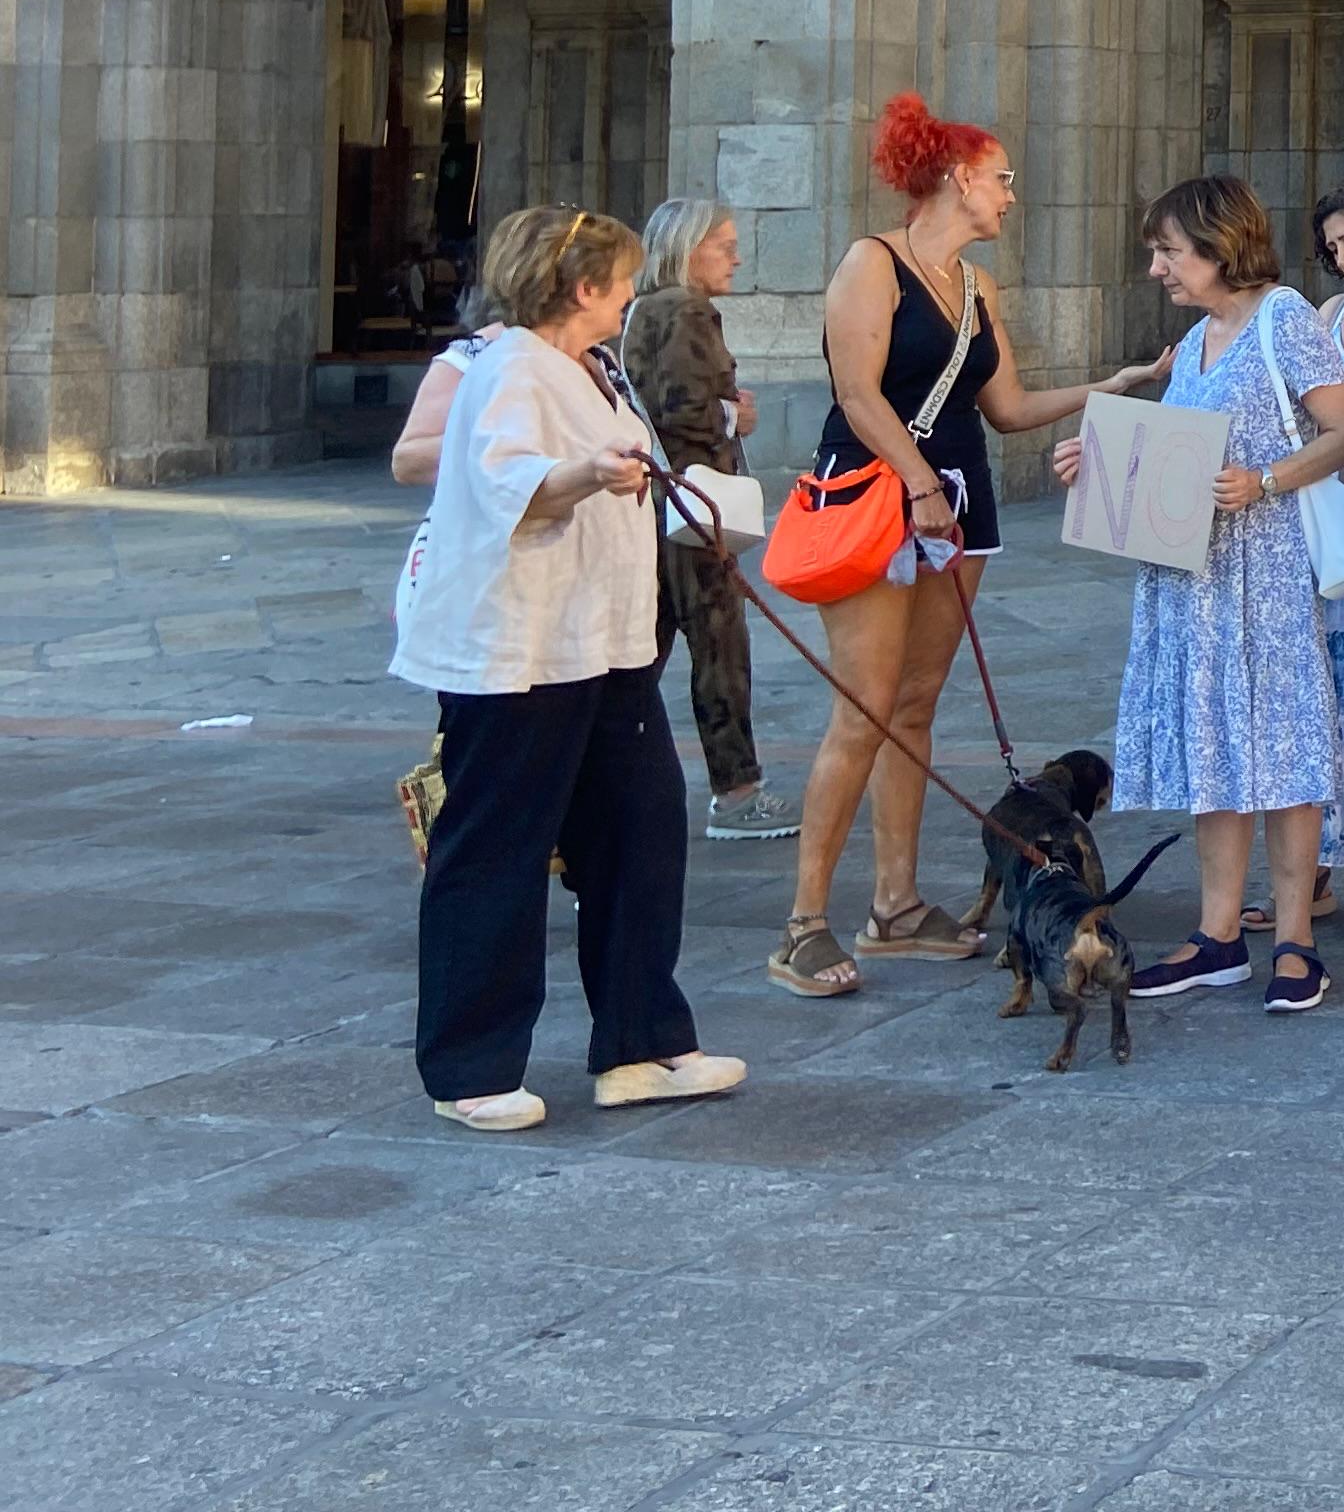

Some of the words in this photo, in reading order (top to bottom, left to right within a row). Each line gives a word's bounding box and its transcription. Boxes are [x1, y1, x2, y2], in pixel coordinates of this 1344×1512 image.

[945, 351, 963, 378] LOLA
[920, 380, 948, 427] CSDMNT
[1070, 416, 1212, 551] NO
